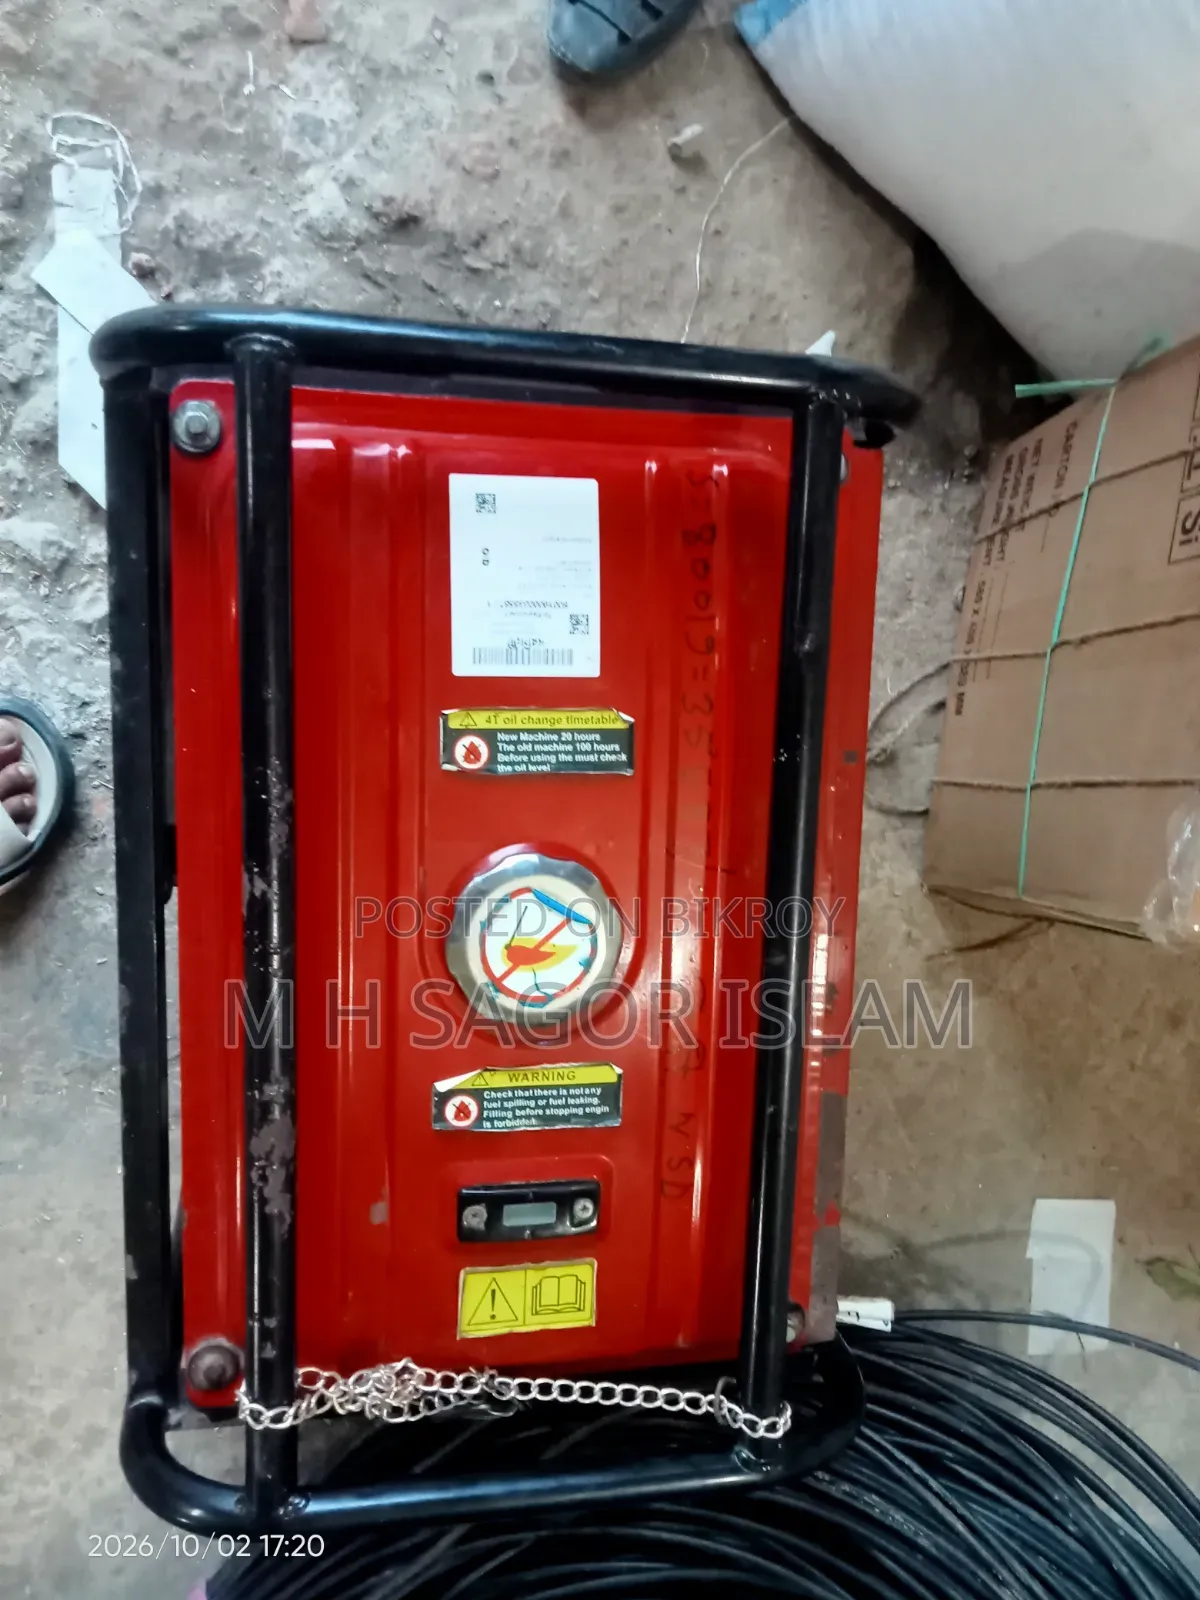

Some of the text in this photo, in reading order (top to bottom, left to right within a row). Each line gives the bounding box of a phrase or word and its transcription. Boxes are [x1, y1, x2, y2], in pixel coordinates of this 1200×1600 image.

[1054, 421, 1078, 490] CARTON
[1015, 438, 1044, 532] NET WEIGT
[982, 453, 1015, 566] MEASUREENT
[485, 714, 618, 728] 4T oil change timetable
[497, 732, 600, 741] New Machine 20 hours
[497, 742, 620, 751] The old machine 100 hours
[497, 752, 627, 764] Before using the must check
[497, 764, 512, 772] the
[514, 763, 526, 772] oil
[508, 1070, 576, 1083] WARNING
[483, 1086, 601, 1099] Check that there is not any
[483, 1100, 501, 1108] fuel
[503, 1099, 535, 1108] spilling
[549, 1097, 566, 1106] fuel
[483, 1105, 609, 1118] Filling before stopping engin
[483, 1120, 491, 1128] is
